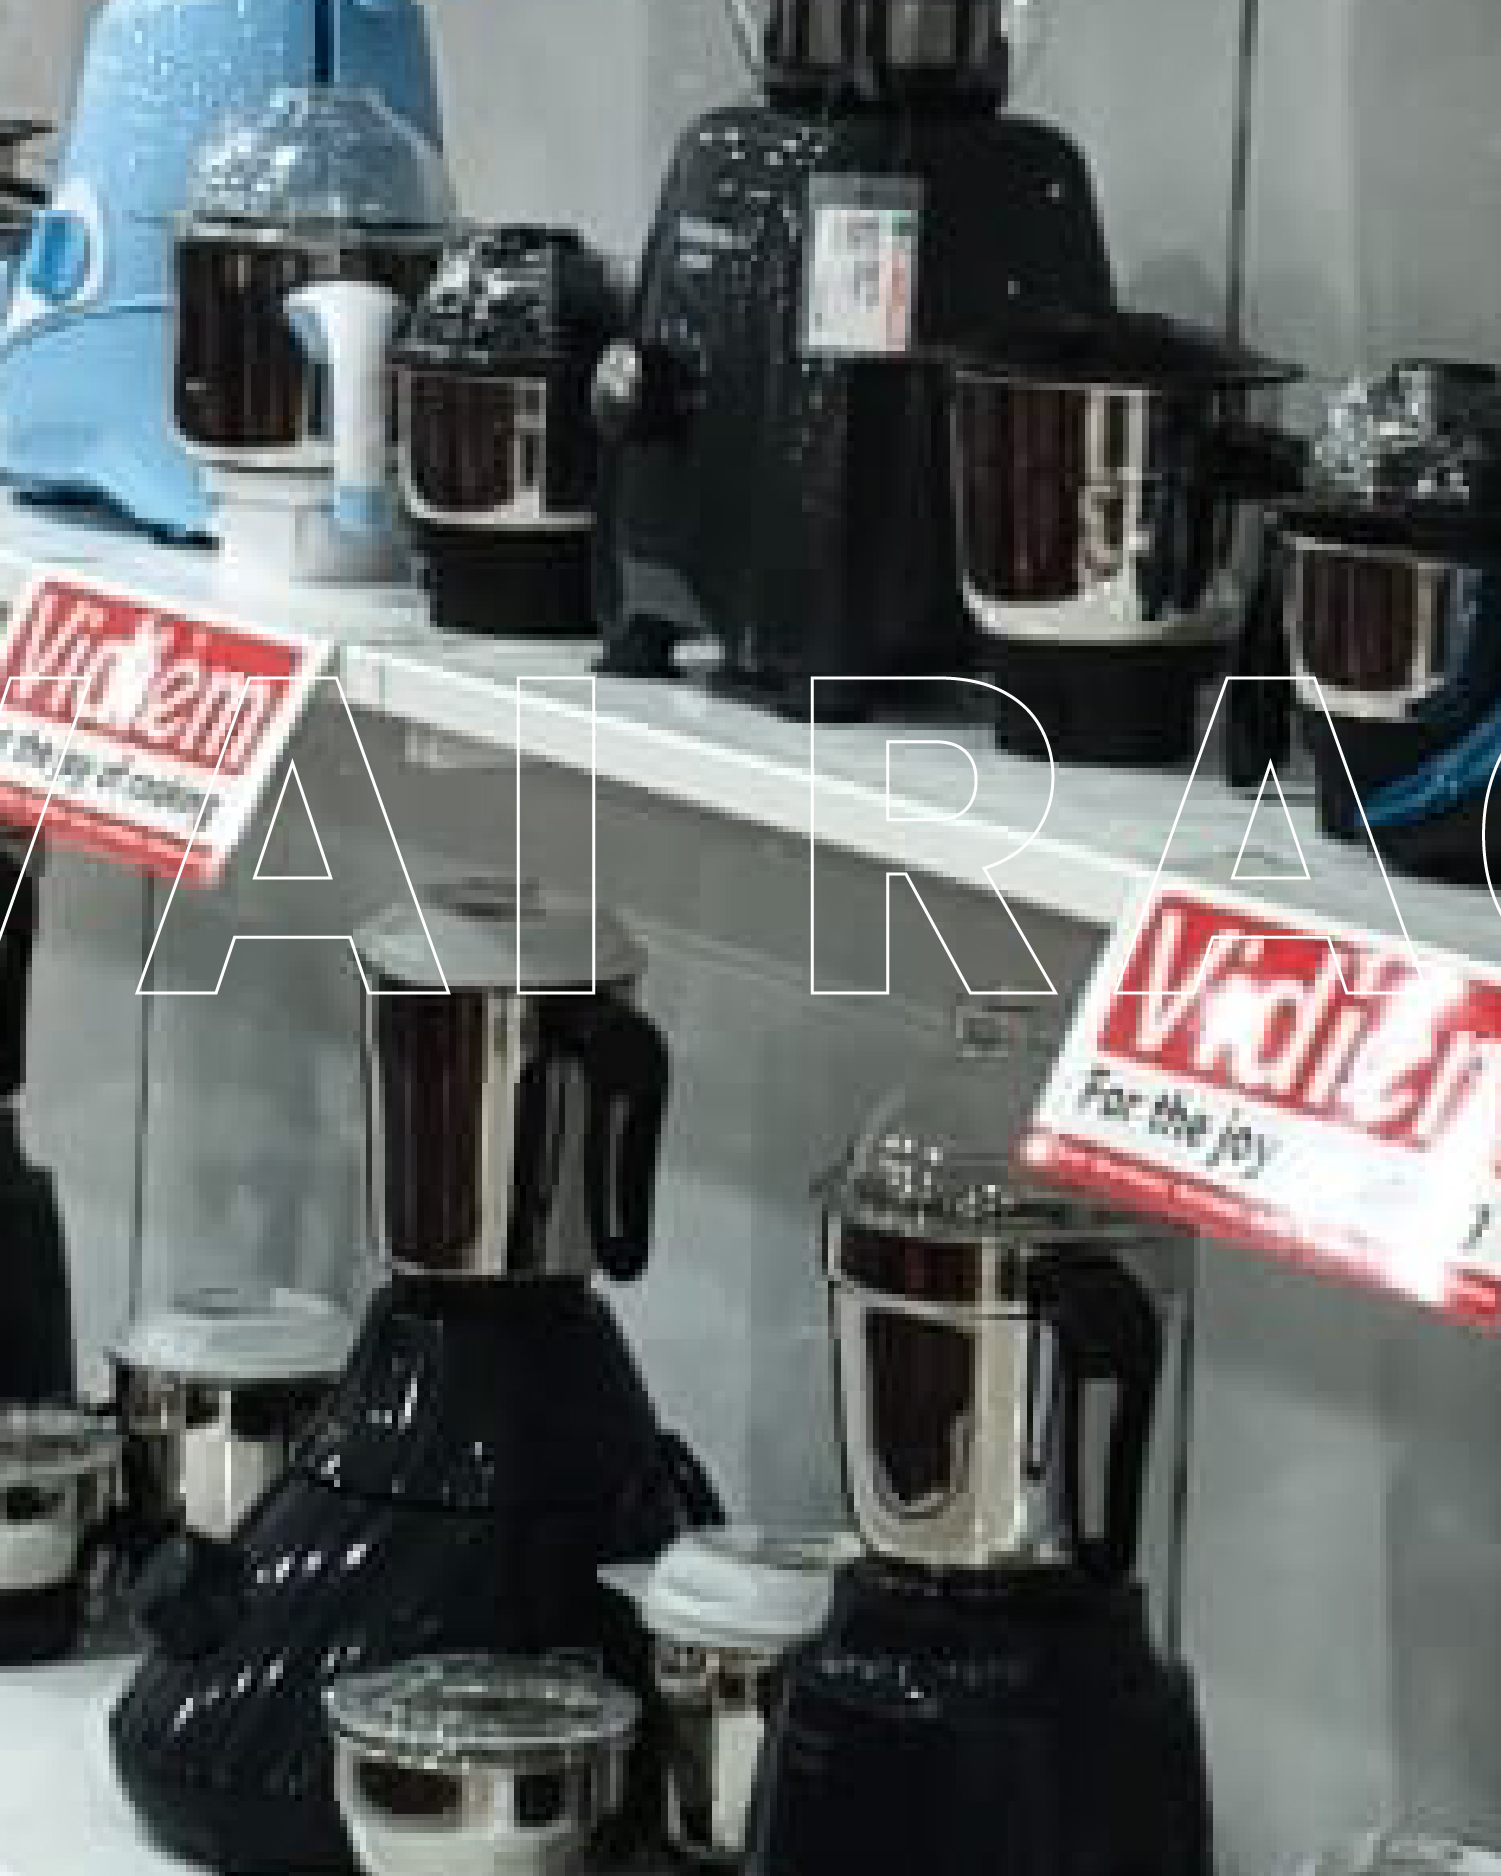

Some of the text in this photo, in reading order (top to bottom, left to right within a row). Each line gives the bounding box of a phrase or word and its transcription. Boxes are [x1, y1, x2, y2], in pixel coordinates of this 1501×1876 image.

[1076, 1068, 1277, 1179] For the joy
